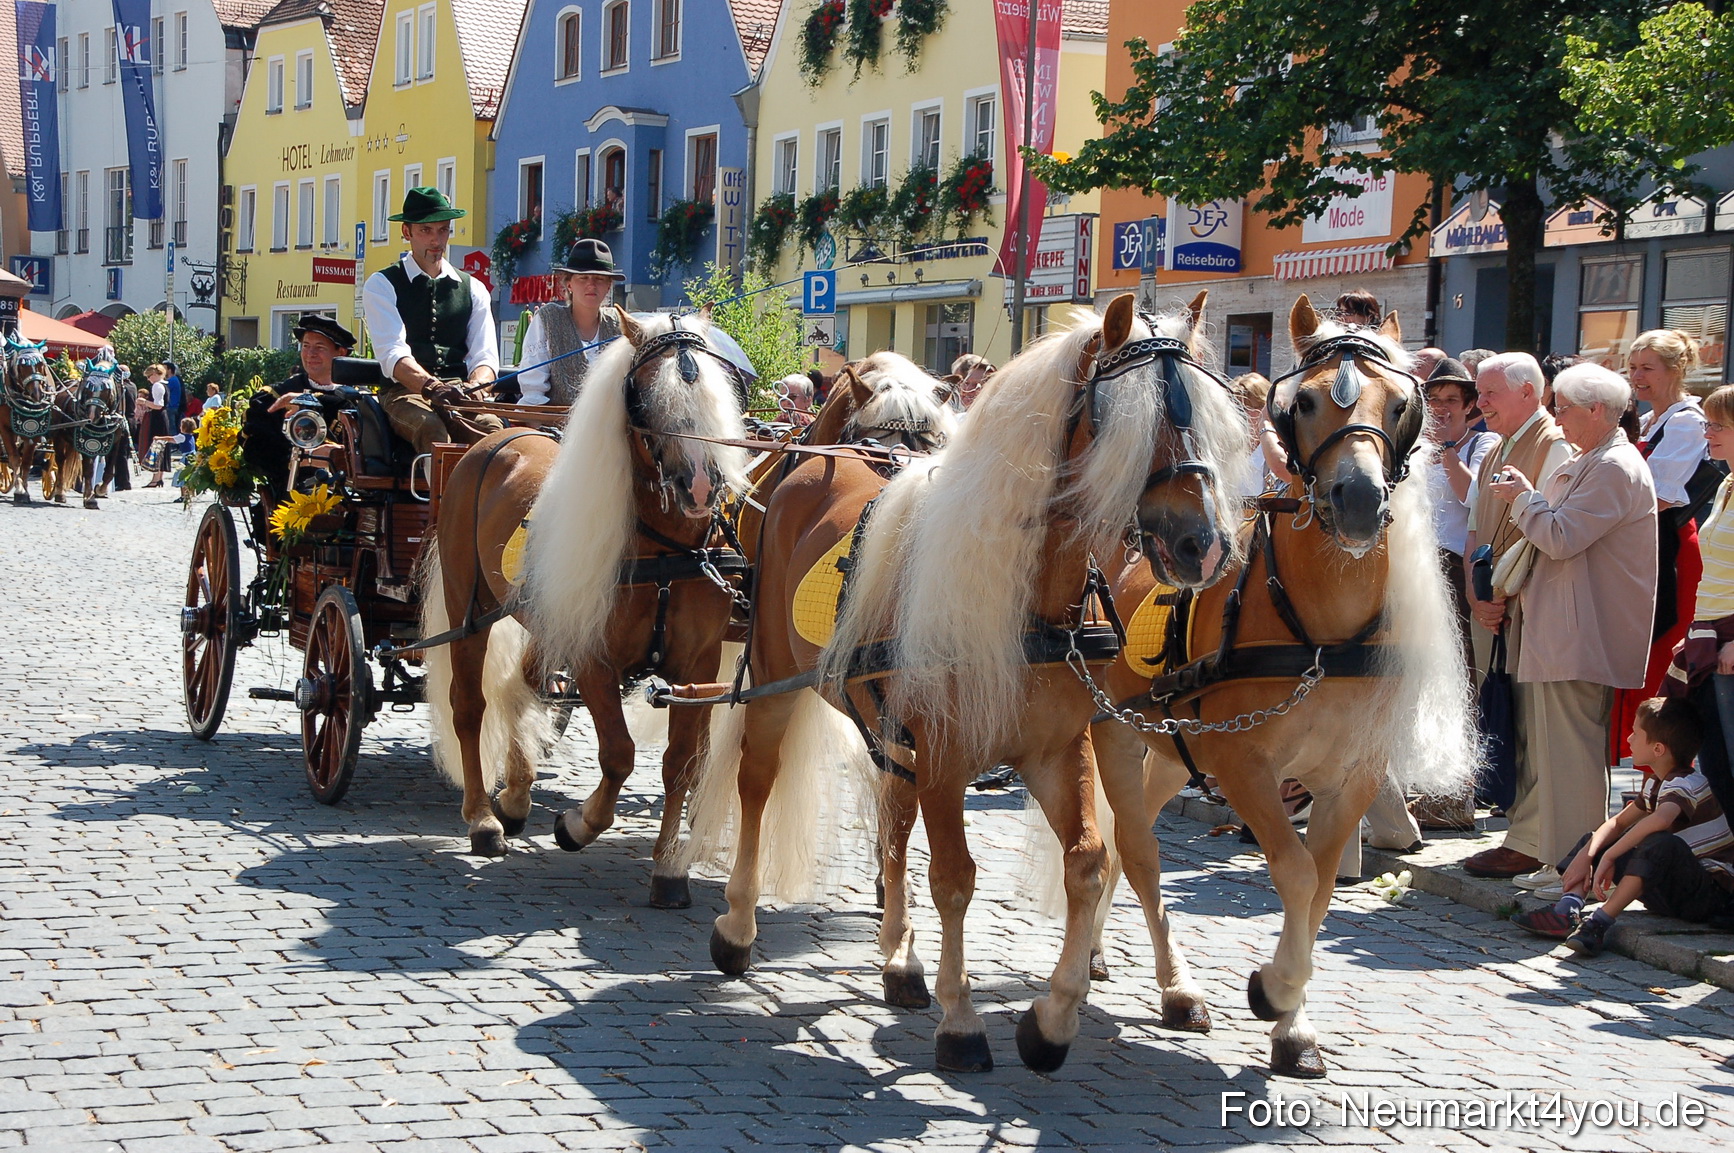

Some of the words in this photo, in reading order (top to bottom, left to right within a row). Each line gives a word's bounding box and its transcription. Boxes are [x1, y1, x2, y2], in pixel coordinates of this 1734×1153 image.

[282, 143, 312, 172] HOTEL
[320, 140, 355, 165] Lehmeier
[723, 169, 743, 188] CAFÉ
[1188, 209, 1229, 227] DER
[1328, 205, 1365, 229] Mode
[356, 227, 364, 255] P
[1143, 226, 1154, 268] P
[1077, 218, 1090, 296] KINO
[1177, 252, 1236, 268] Reisebüro
[314, 265, 355, 277] WISSMACH
[276, 280, 320, 299] Restaurant
[810, 275, 829, 309] P
